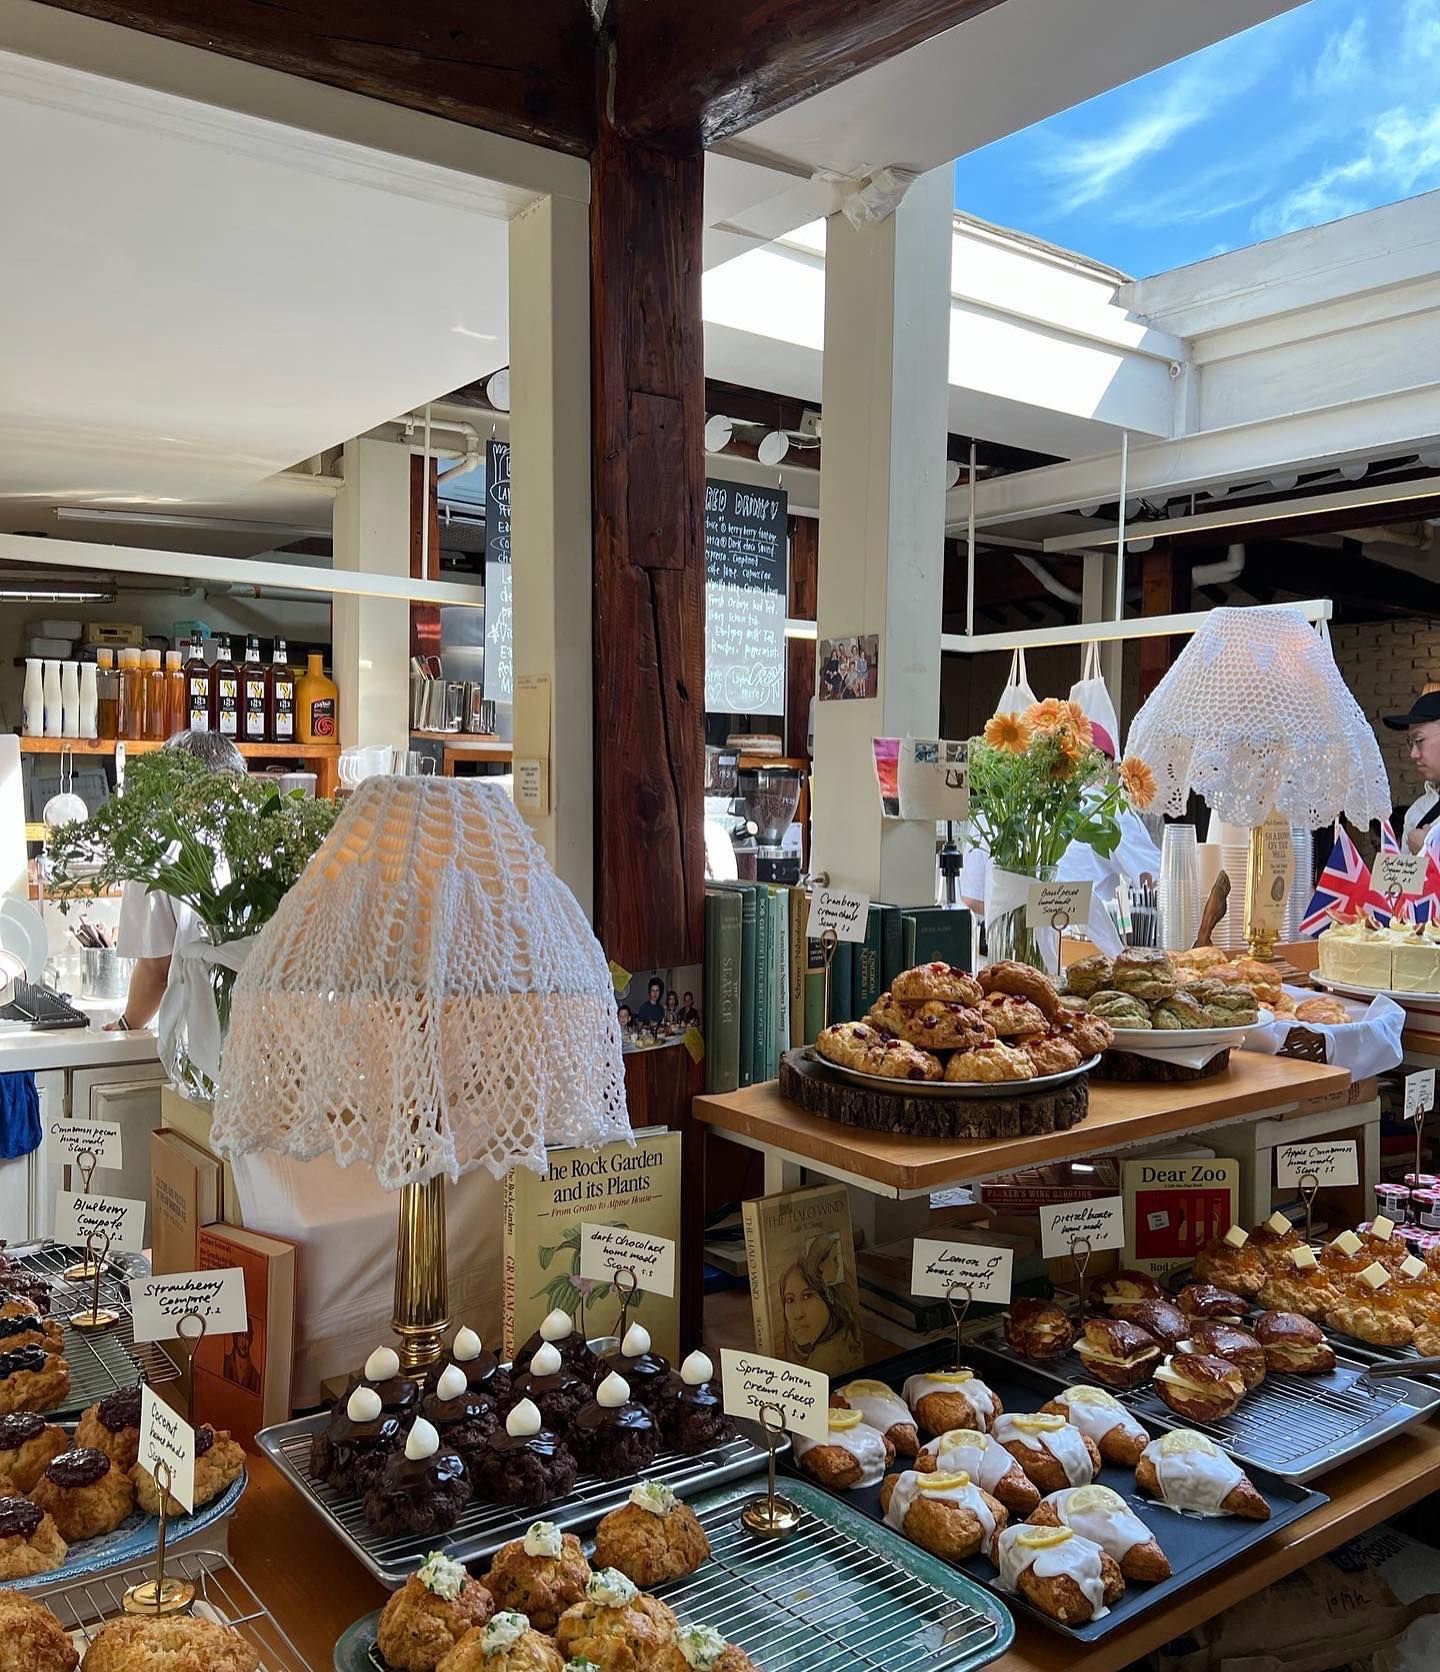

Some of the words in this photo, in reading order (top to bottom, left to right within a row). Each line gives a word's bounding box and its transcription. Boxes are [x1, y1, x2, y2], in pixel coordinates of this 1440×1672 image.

[721, 957, 733, 1024] SEARCH
[571, 1156, 608, 1178] Rock
[610, 1150, 663, 1172] Garden
[1141, 1167, 1187, 1183] Dear
[1191, 1165, 1227, 1182] Zoo
[553, 1181, 582, 1204] and
[586, 1180, 603, 1199] its
[607, 1175, 650, 1195] Plants
[987, 1189, 1026, 1198] PARKER'S
[1028, 1189, 1049, 1198] WINE
[1052, 1190, 1092, 1199] BARGAINS
[73, 1198, 128, 1221] Blueberry
[551, 1208, 571, 1217] From
[573, 1204, 597, 1214] Grotto
[607, 1199, 630, 1211] Alpine
[77, 1214, 123, 1232] Compote
[507, 1204, 515, 1235] Garden
[768, 1214, 787, 1229] THE
[591, 1231, 613, 1243] dark
[603, 1246, 628, 1258] home
[630, 1252, 657, 1265] made
[603, 1257, 636, 1272] Scone
[745, 1216, 753, 1237] THE
[751, 1271, 760, 1300] WIND
[938, 1249, 979, 1266] Lemon
[960, 1269, 994, 1280] made
[1150, 1262, 1169, 1272] Rod
[144, 1279, 224, 1297] Strawberry
[507, 1256, 515, 1311] GRAHAM
[736, 1360, 778, 1384] Spring
[781, 1371, 812, 1388] Onion
[151, 1402, 178, 1439] Coconut
